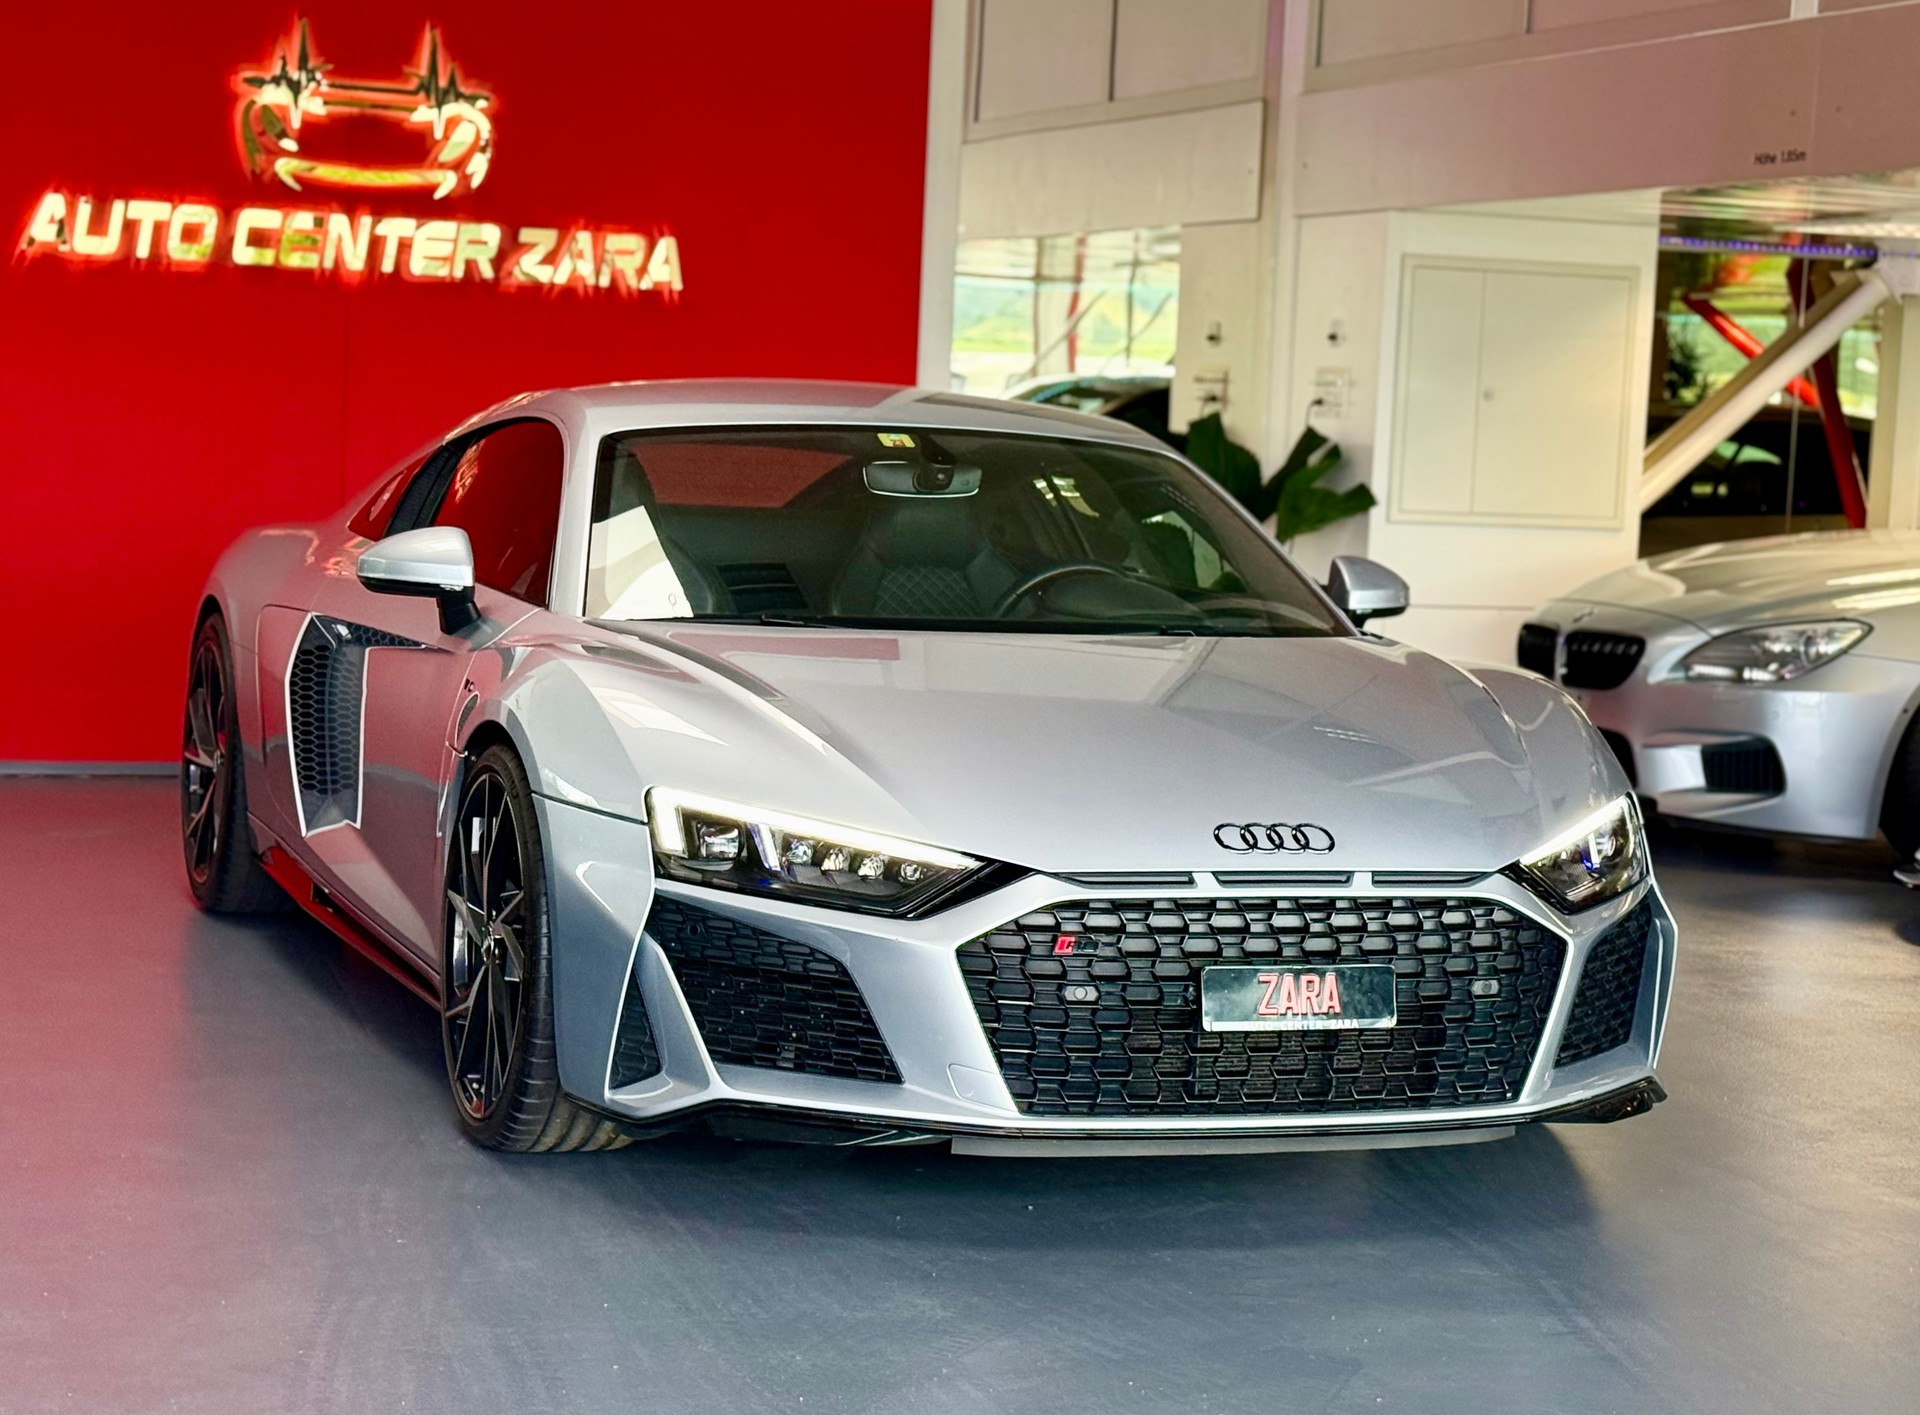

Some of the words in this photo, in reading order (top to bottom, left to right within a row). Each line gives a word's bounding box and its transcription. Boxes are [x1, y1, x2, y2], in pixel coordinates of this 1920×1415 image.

[25, 192, 219, 260] AUTO
[231, 206, 500, 280] CENTER
[512, 226, 685, 292] ZARA
[1257, 972, 1341, 1017] ZARA
[1244, 1020, 1273, 1031] AUTO
[1280, 1019, 1324, 1031] CENTER
[1330, 1018, 1360, 1030] ZARA
